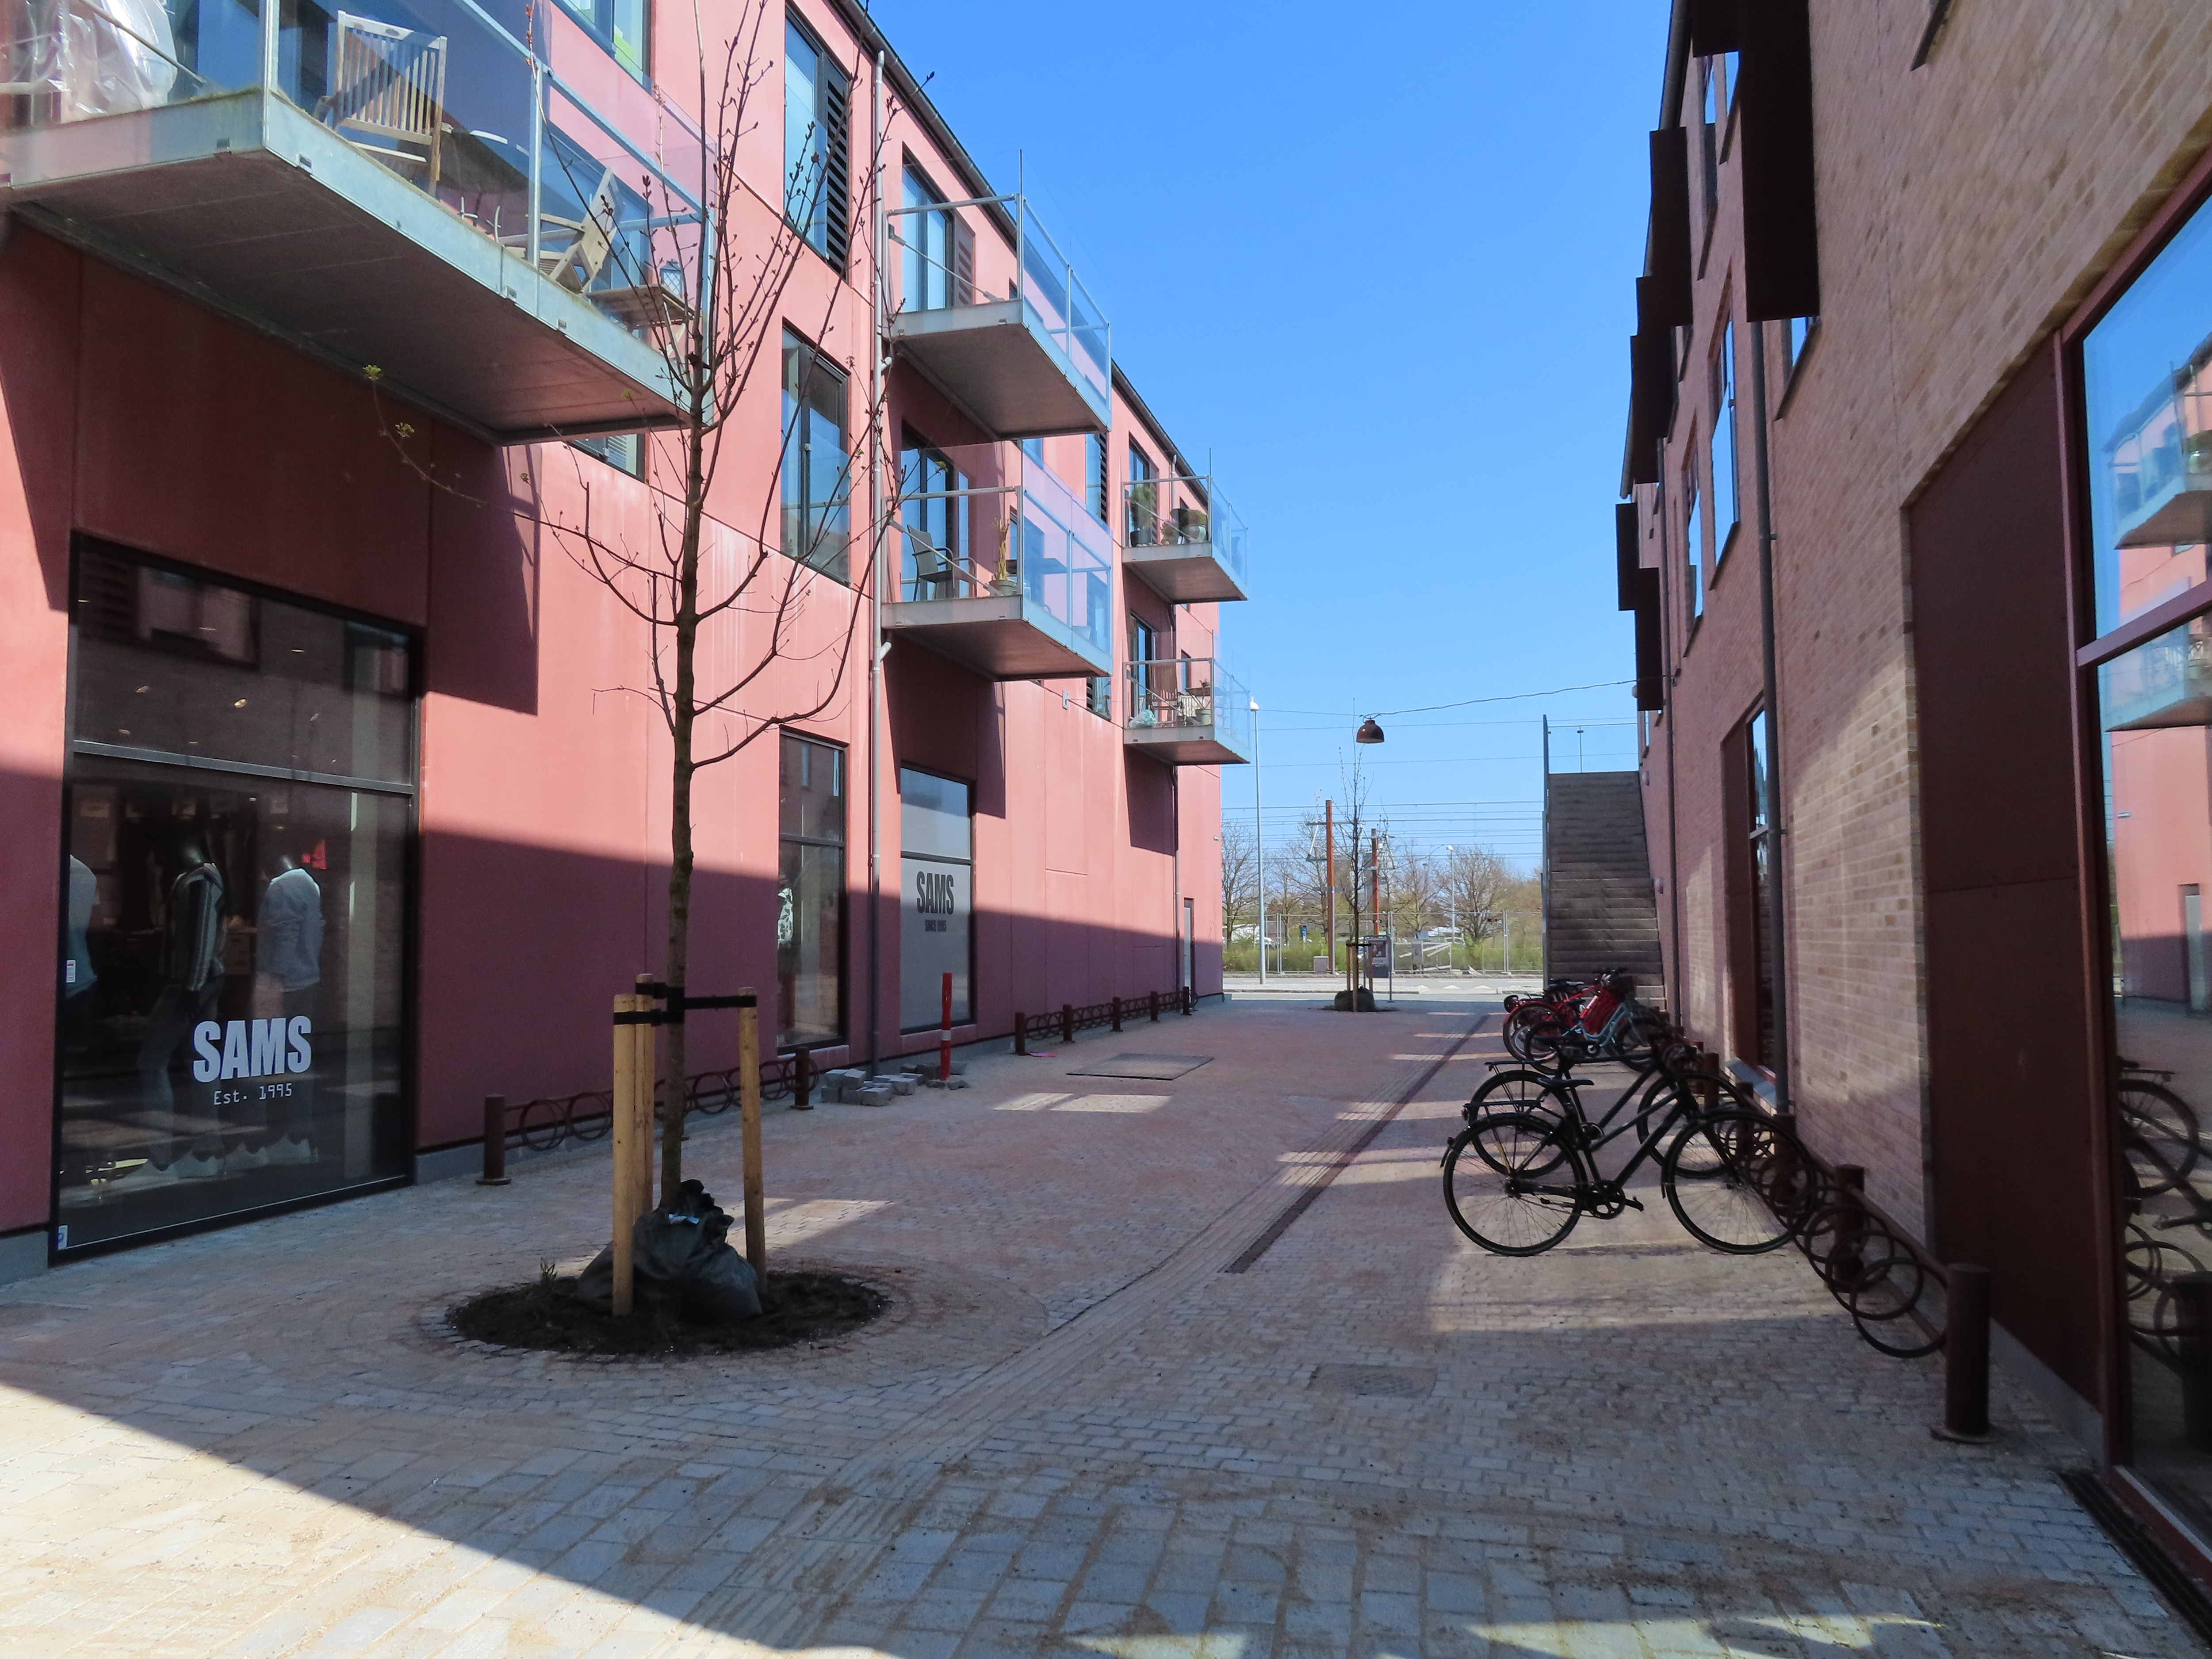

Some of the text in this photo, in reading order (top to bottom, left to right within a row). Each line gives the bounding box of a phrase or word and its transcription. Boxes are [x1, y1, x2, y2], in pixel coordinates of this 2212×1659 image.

[917, 871, 954, 915] SAMS
[193, 1016, 311, 1082] SAMS
[214, 1083, 292, 1105] Est. 1995
